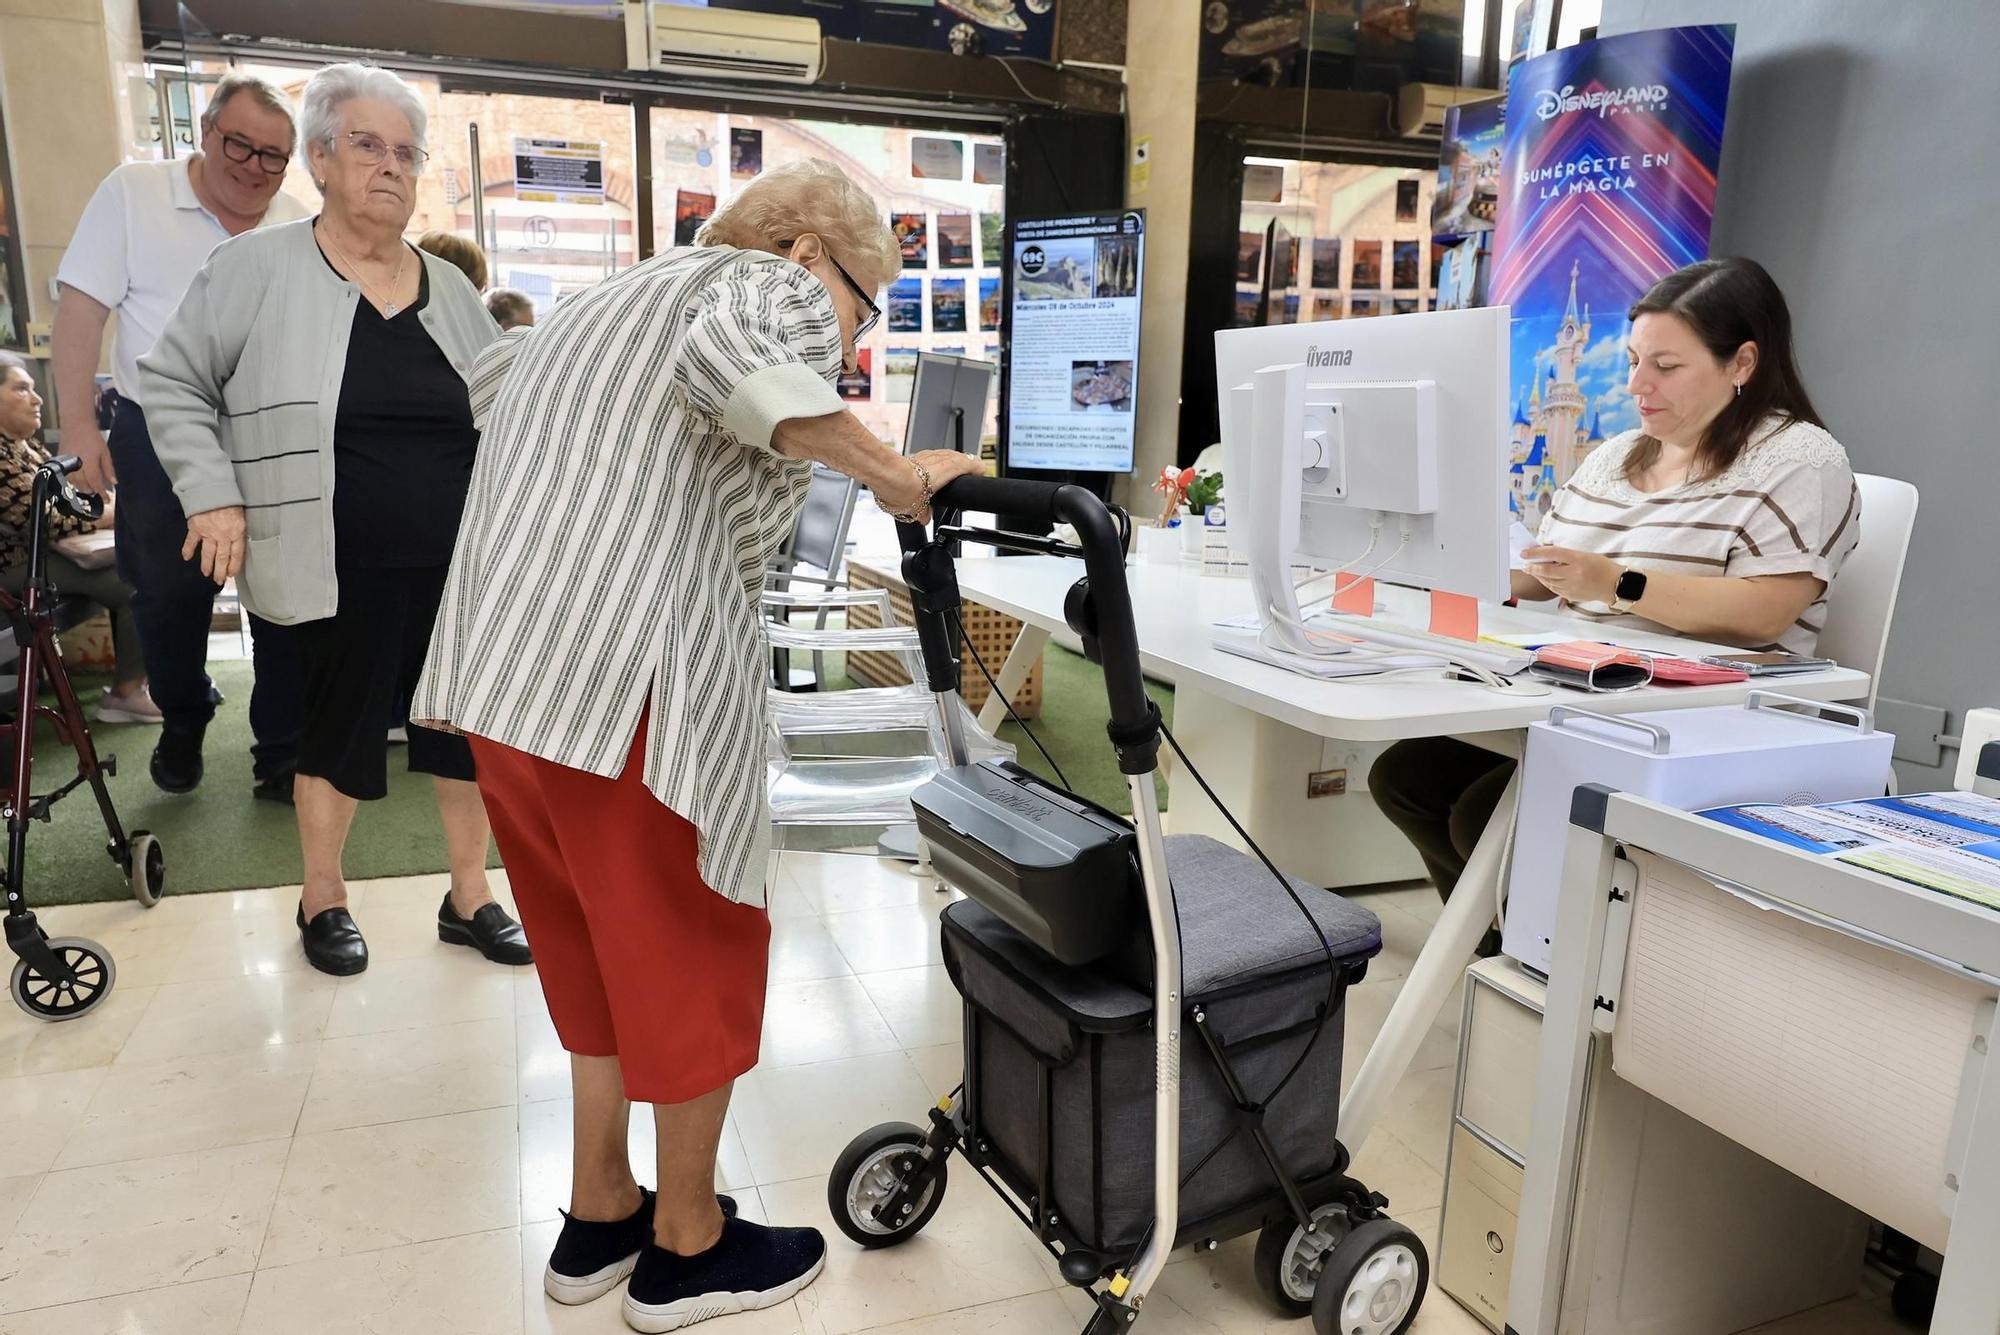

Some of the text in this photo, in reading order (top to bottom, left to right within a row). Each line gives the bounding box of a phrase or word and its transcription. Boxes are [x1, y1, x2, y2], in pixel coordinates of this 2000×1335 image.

[1610, 102, 1667, 116] PARIS
[1520, 152, 1669, 185] SUMÉRGETE EN
[1540, 176, 1636, 200] LA MAGIA
[528, 219, 551, 245] 15
[1022, 251, 1043, 263] 69€
[1069, 301, 1096, 310] Octubre
[1306, 344, 1353, 367] iiyama
